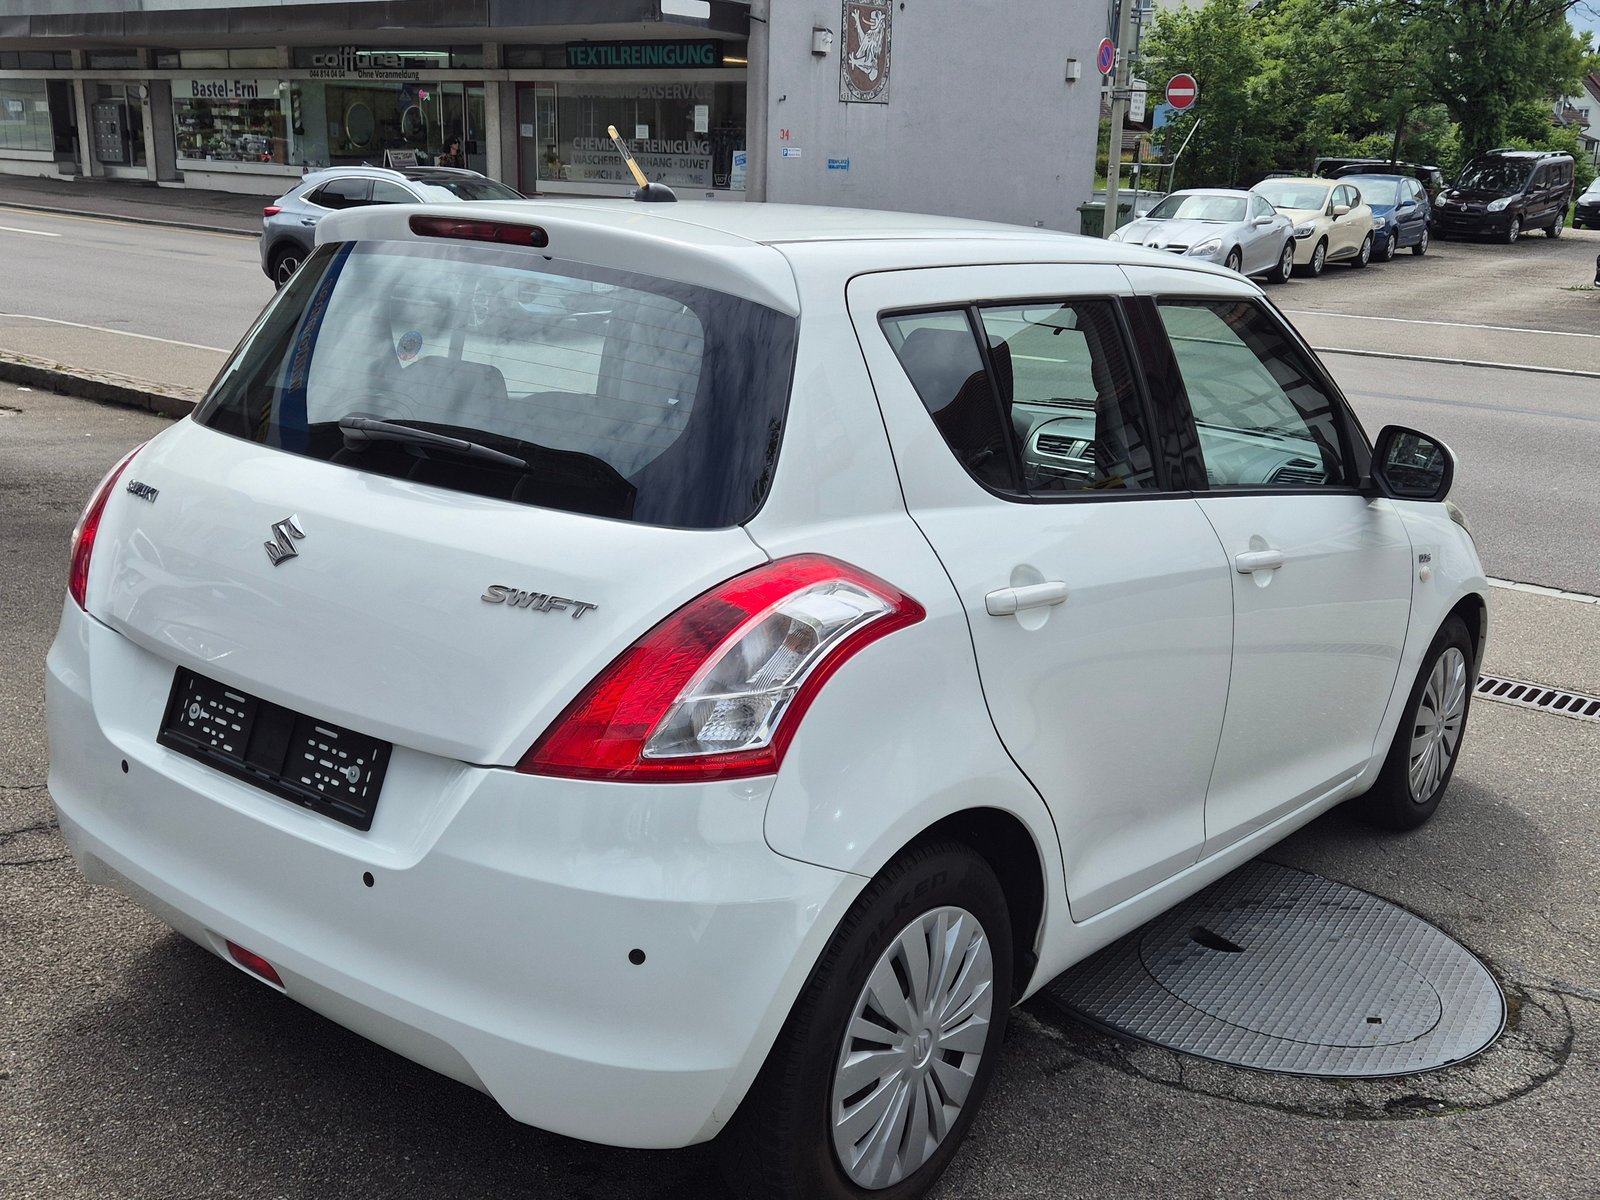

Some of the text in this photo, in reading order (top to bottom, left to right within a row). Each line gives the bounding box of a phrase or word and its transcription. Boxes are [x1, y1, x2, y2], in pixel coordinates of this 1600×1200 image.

[567, 44, 714, 65] TEXTILREINIGUNG
[309, 70, 319, 78] 044
[320, 70, 330, 78] 814
[358, 70, 420, 80] Ohne Voranmeldung
[191, 80, 259, 98] Bastel-Erni
[572, 137, 710, 154] CHEMISHE REINIGUNG
[632, 157, 673, 168] ORHANG
[679, 158, 710, 170] DUVET
[480, 584, 599, 619] SWIFT
